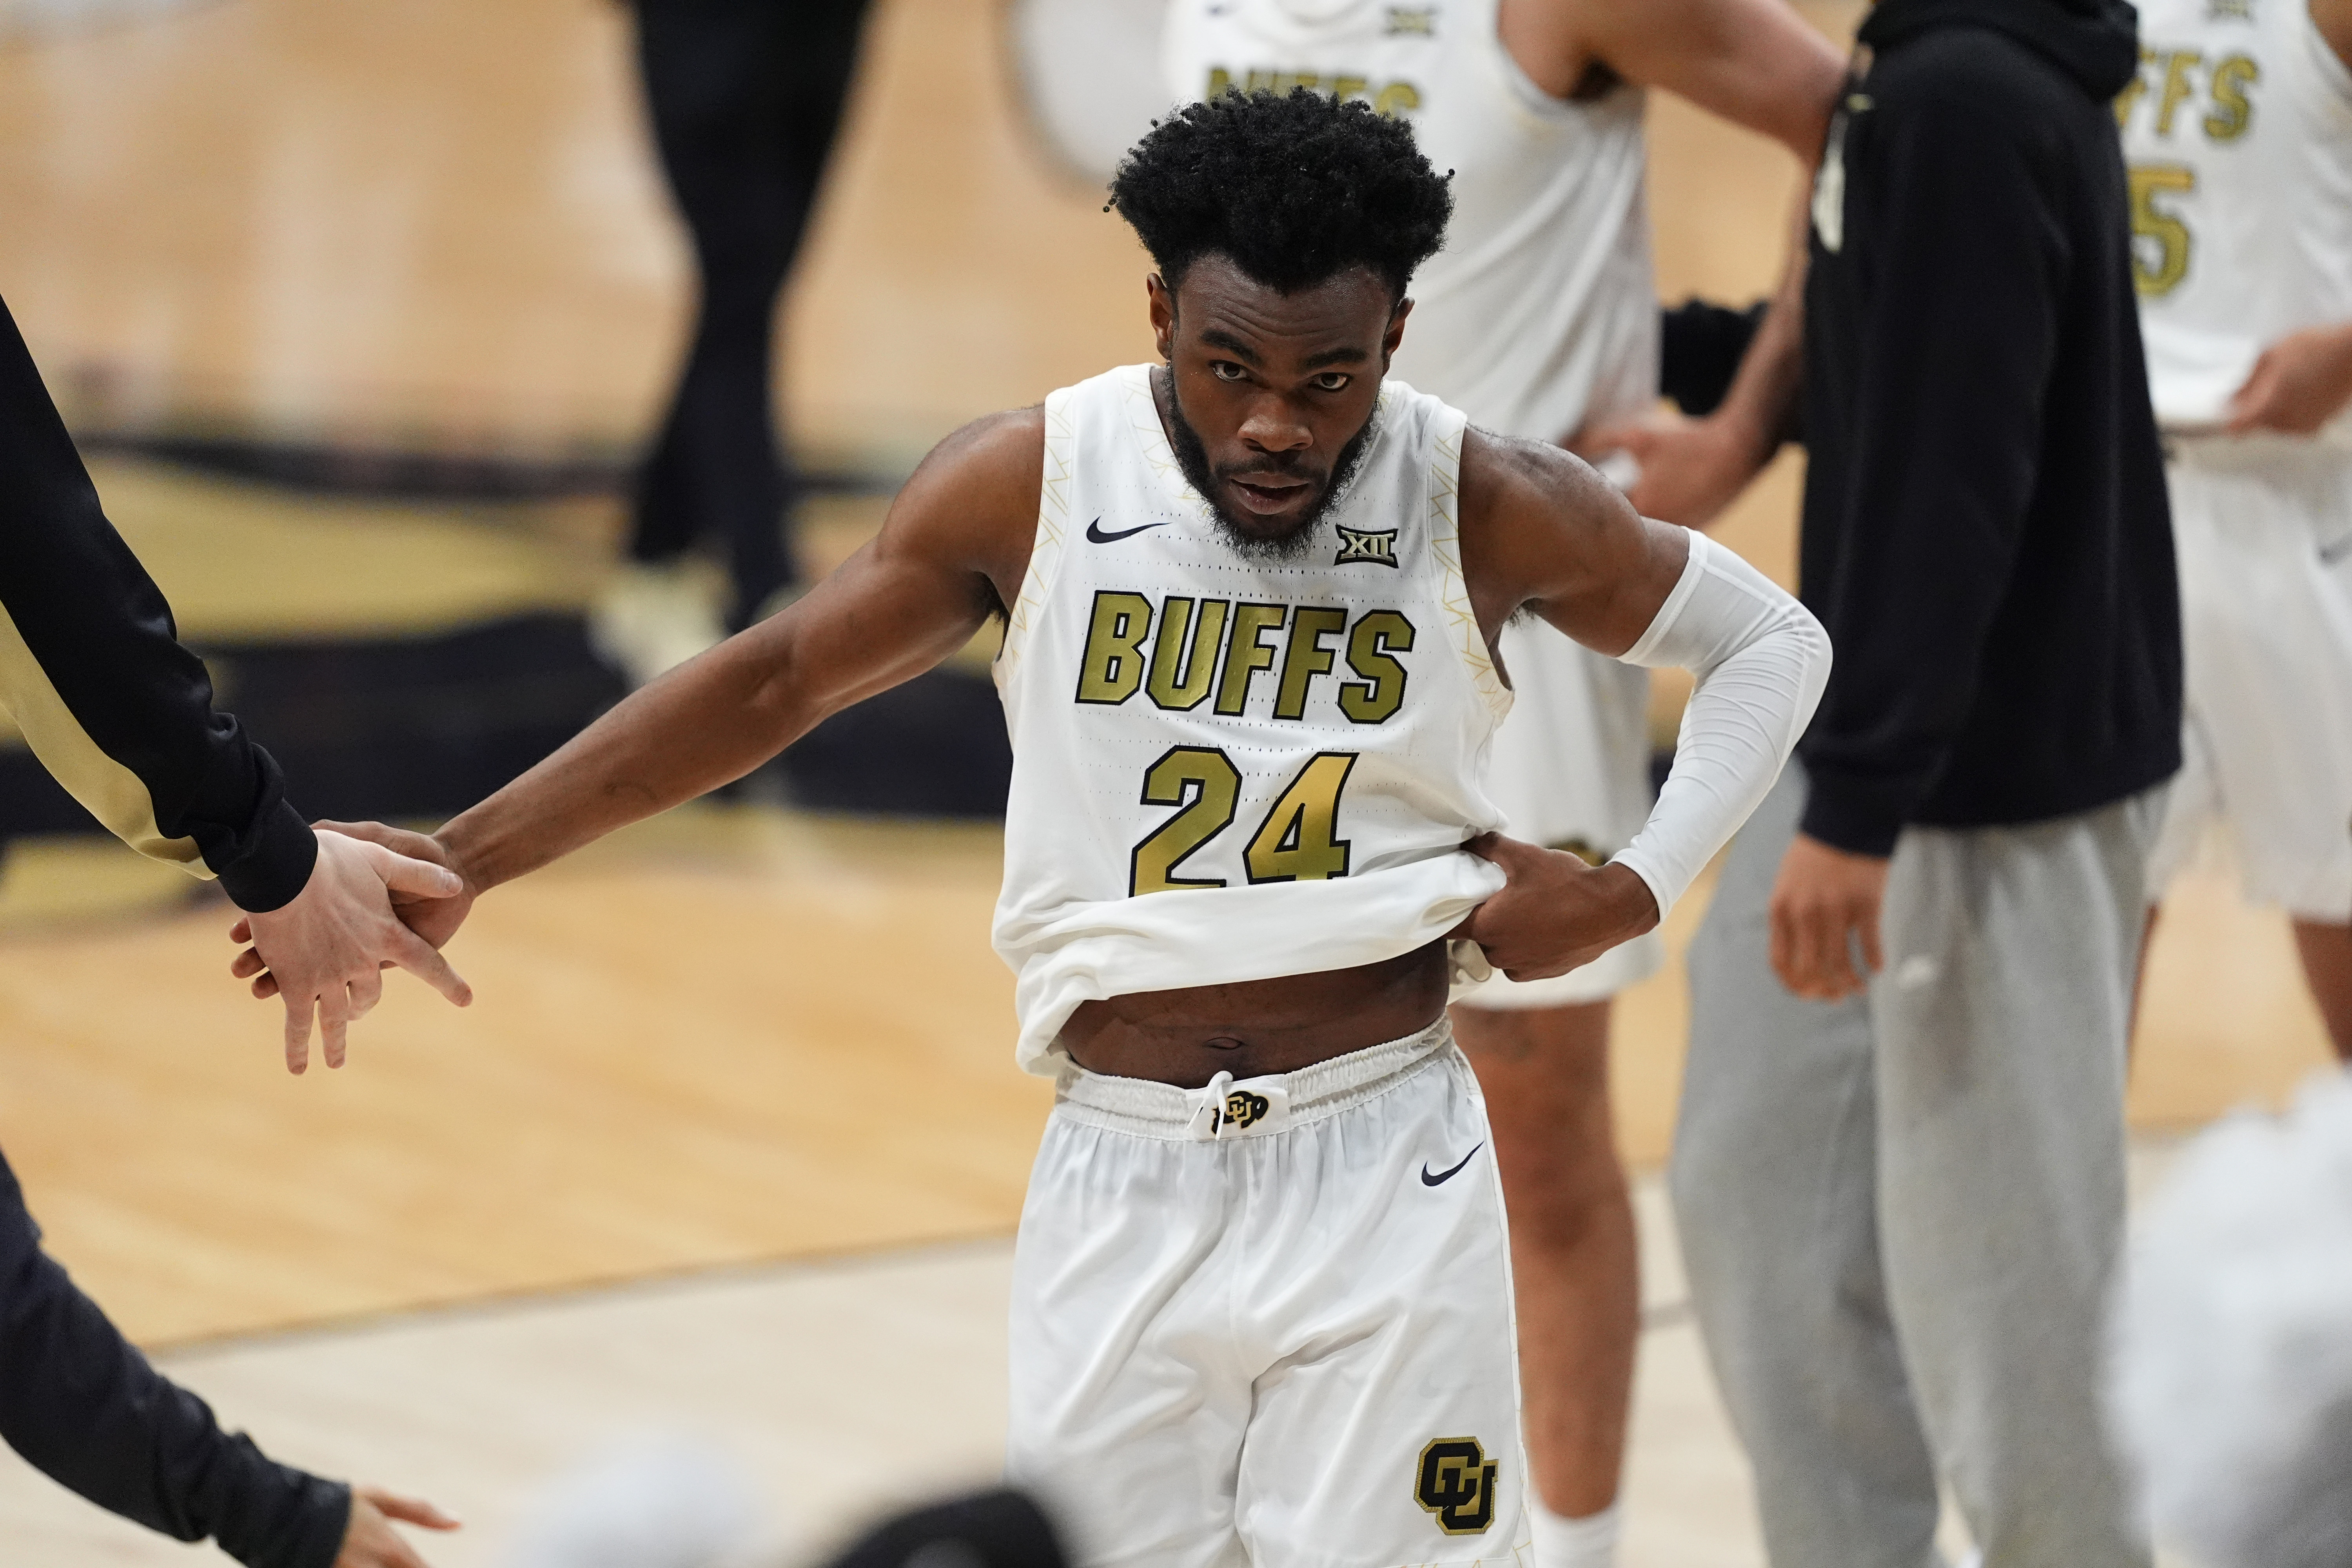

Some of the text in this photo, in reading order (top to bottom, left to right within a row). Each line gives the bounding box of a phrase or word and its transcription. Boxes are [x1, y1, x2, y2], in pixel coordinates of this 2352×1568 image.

[1338, 528, 1396, 565] XII
[1074, 590, 1415, 724] BUFFS
[1128, 744, 1359, 898] 24
[1414, 1436, 1499, 1535] CU
